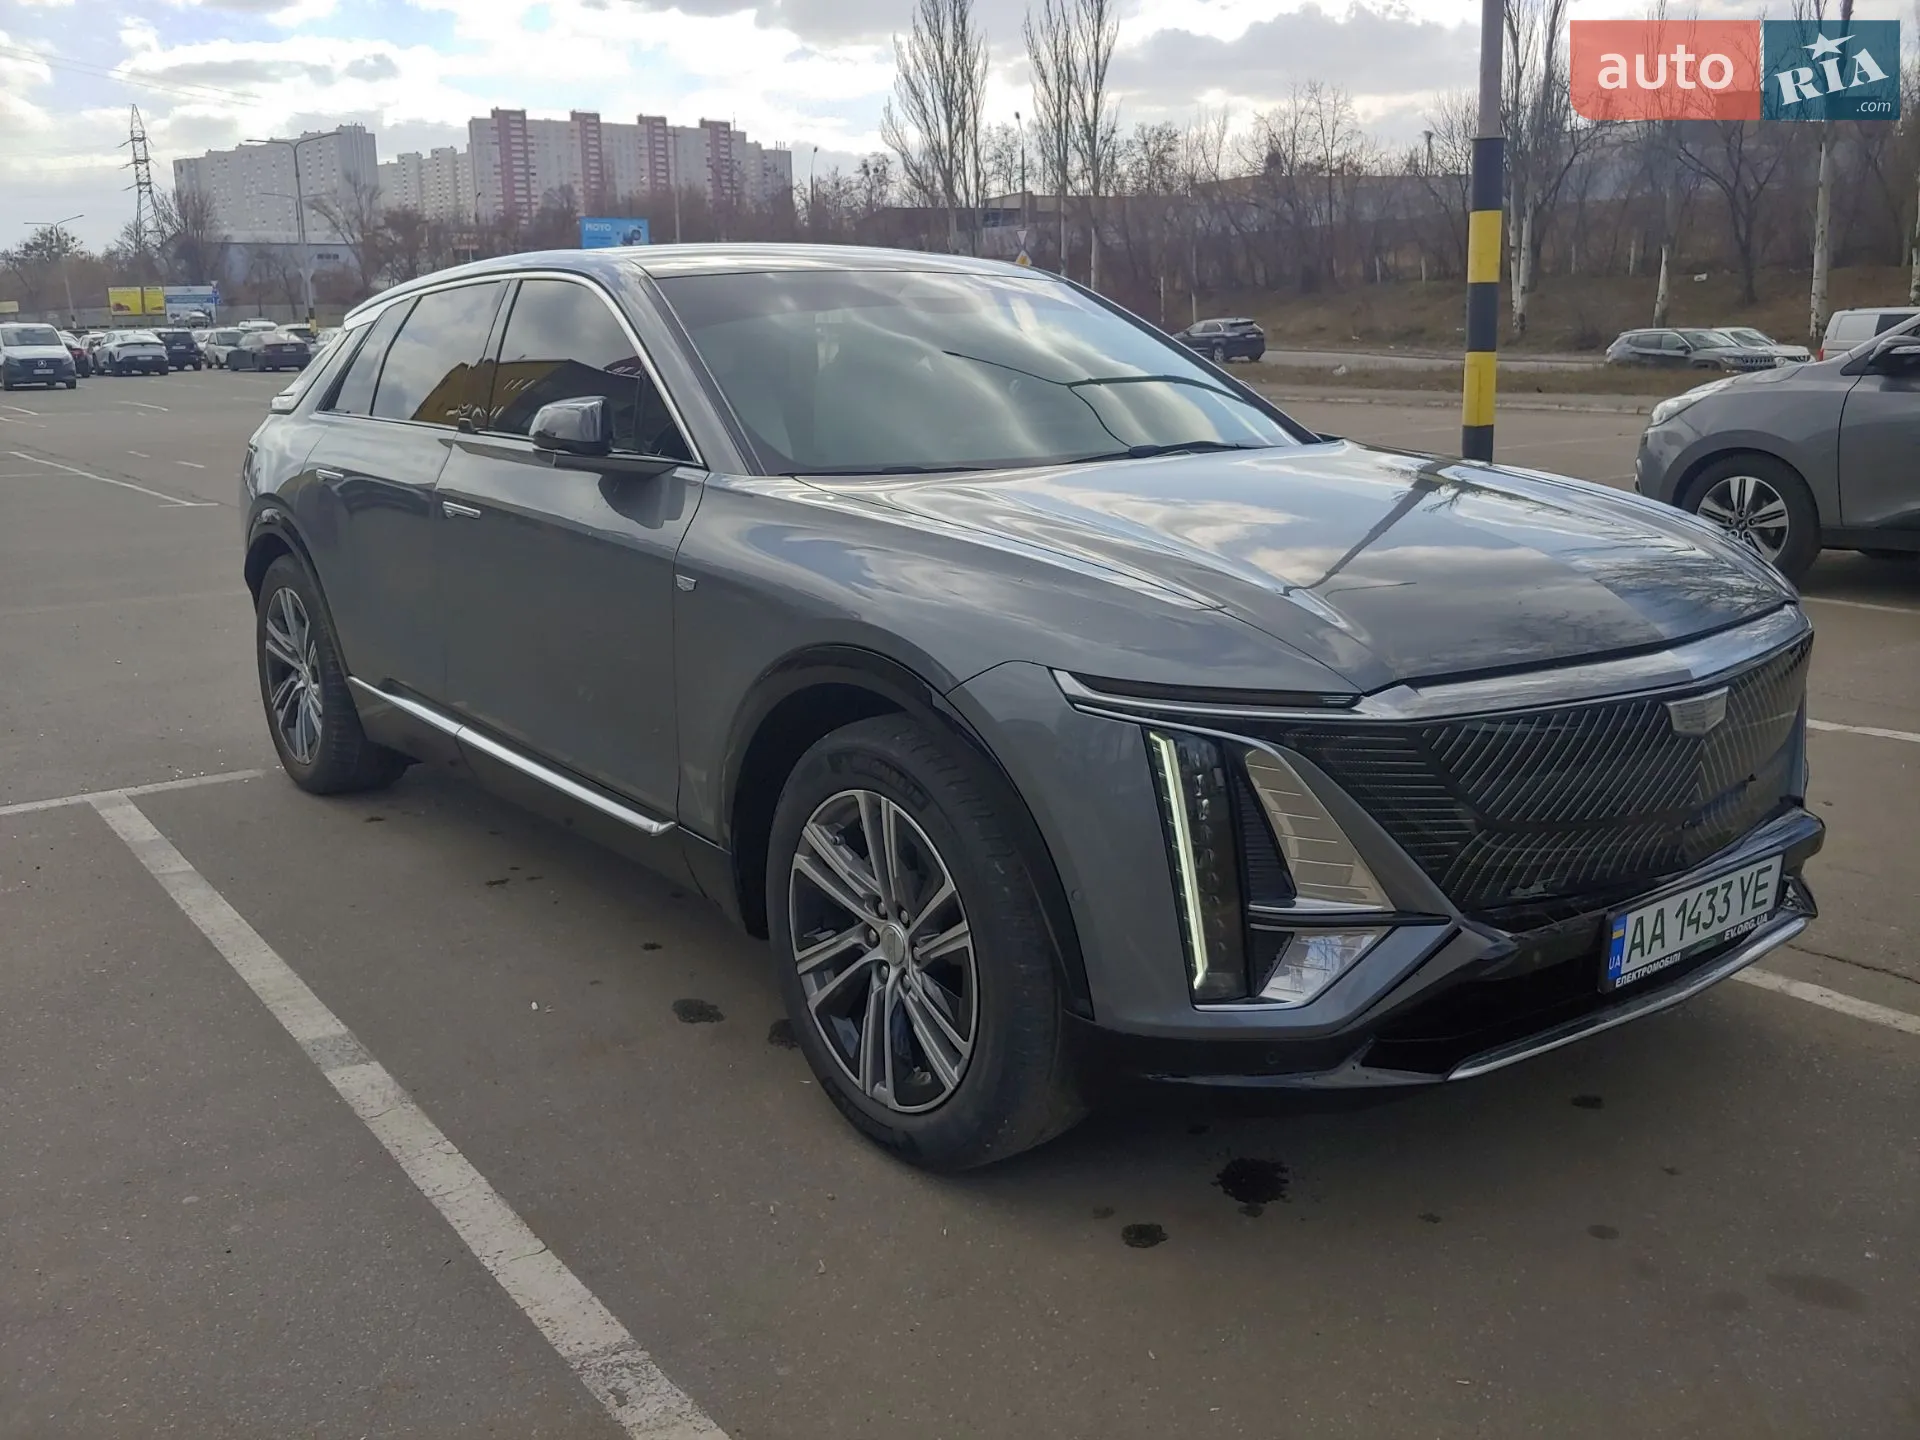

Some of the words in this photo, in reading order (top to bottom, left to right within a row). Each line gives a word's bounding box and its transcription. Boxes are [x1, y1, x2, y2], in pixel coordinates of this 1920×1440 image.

[1627, 908, 1665, 963] AA
[1675, 880, 1733, 940] 1433
[1740, 865, 1773, 916] YE
[1608, 955, 1621, 970] UA
